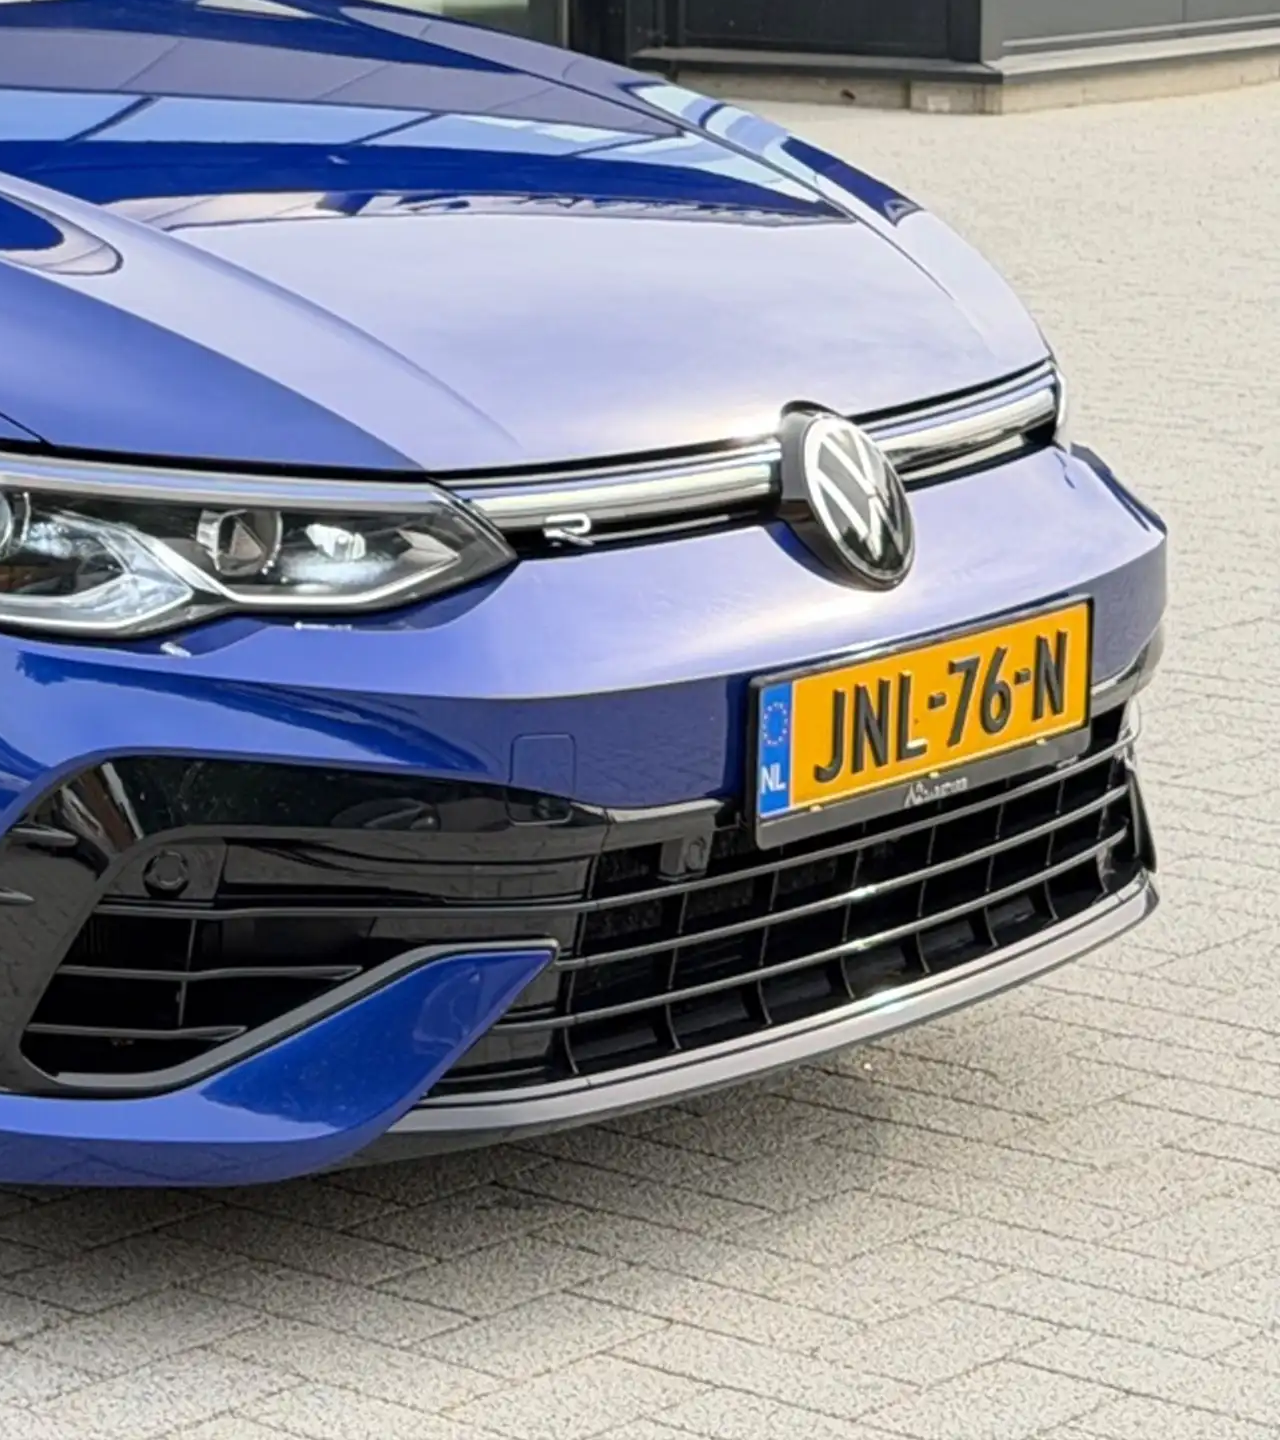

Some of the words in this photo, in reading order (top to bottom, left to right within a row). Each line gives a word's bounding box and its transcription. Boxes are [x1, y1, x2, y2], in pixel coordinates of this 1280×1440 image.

[543, 513, 594, 546] R
[813, 629, 1068, 783] JNL-76-N
[760, 762, 788, 795] NL
